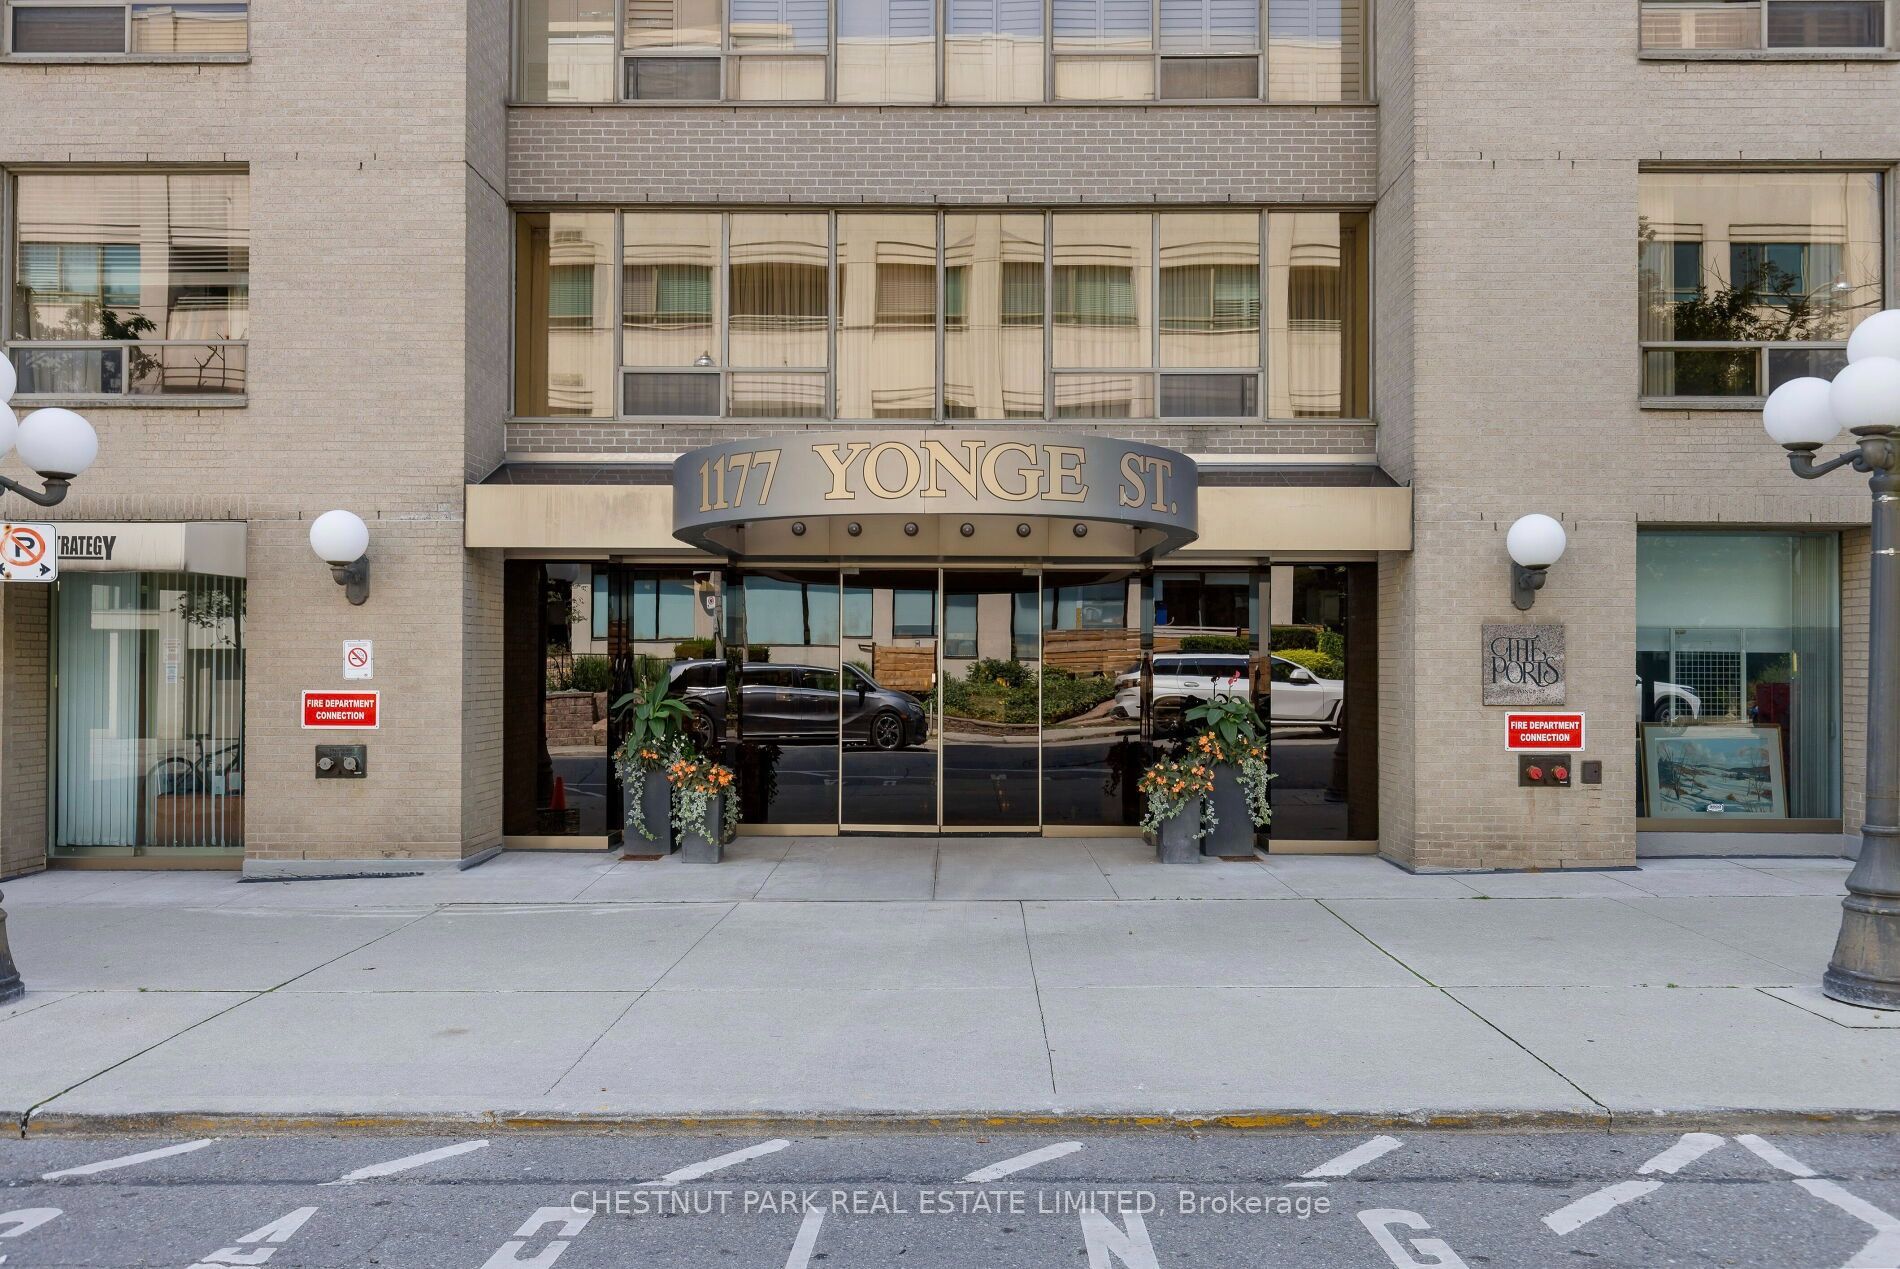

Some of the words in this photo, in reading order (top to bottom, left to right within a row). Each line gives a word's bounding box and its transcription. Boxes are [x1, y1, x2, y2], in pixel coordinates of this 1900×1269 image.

[699, 448, 782, 513] 1177
[812, 440, 1090, 503] YONGE
[1119, 451, 1177, 515] ST.
[1492, 656, 1559, 687] PORTS
[306, 699, 324, 708] FIRE
[325, 699, 375, 708] DEPARTMENT
[315, 711, 365, 720] CONNECTION
[1510, 721, 1528, 730] FIRE
[1529, 721, 1580, 730] DEPARTMENT
[1520, 733, 1570, 742] CONNECTION
